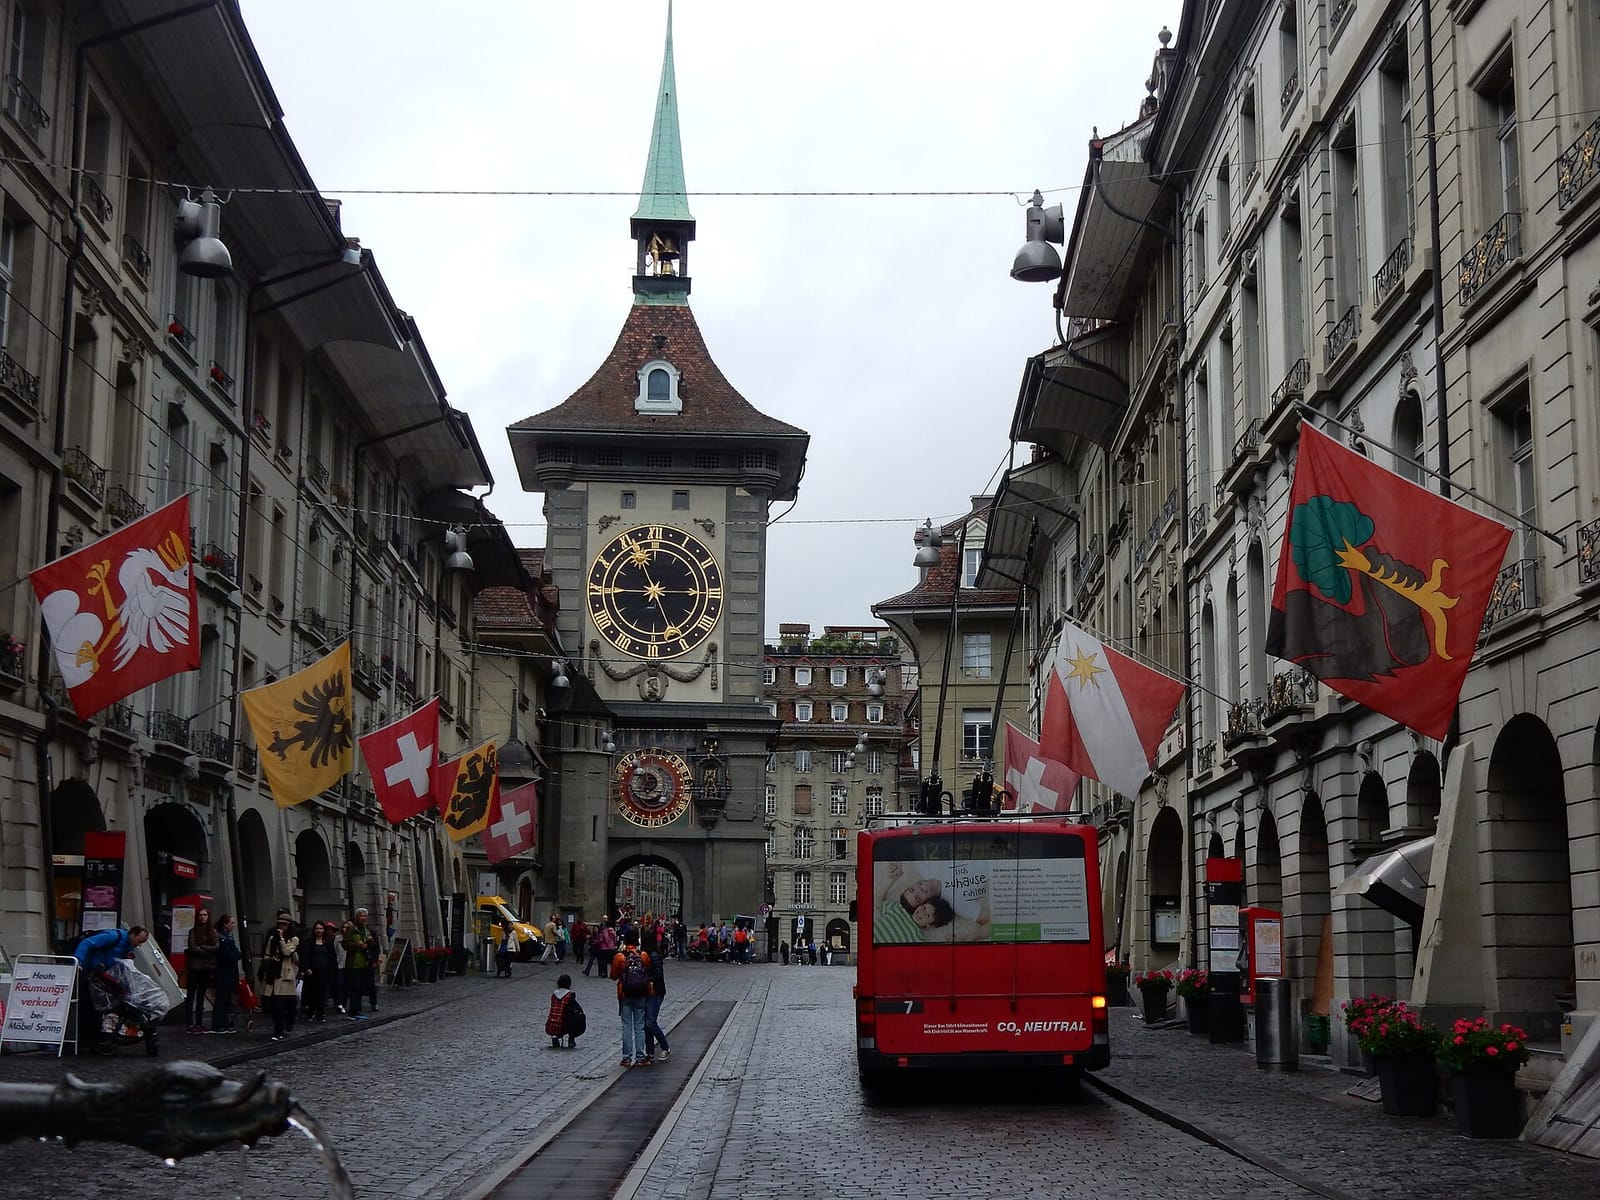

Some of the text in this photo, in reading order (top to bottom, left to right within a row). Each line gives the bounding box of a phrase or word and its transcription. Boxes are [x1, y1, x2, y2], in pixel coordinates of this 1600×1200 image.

[921, 842, 939, 860] 12
[945, 874, 987, 888] zuhause
[32, 971, 56, 980] Heute
[15, 983, 69, 995] Räumungs-
[21, 997, 60, 1007] verkauf
[904, 1001, 914, 1014] 7
[30, 1010, 45, 1019] bei
[8, 1022, 62, 1034] Möbel Spring
[1023, 1021, 1087, 1032] NEUTRAL
